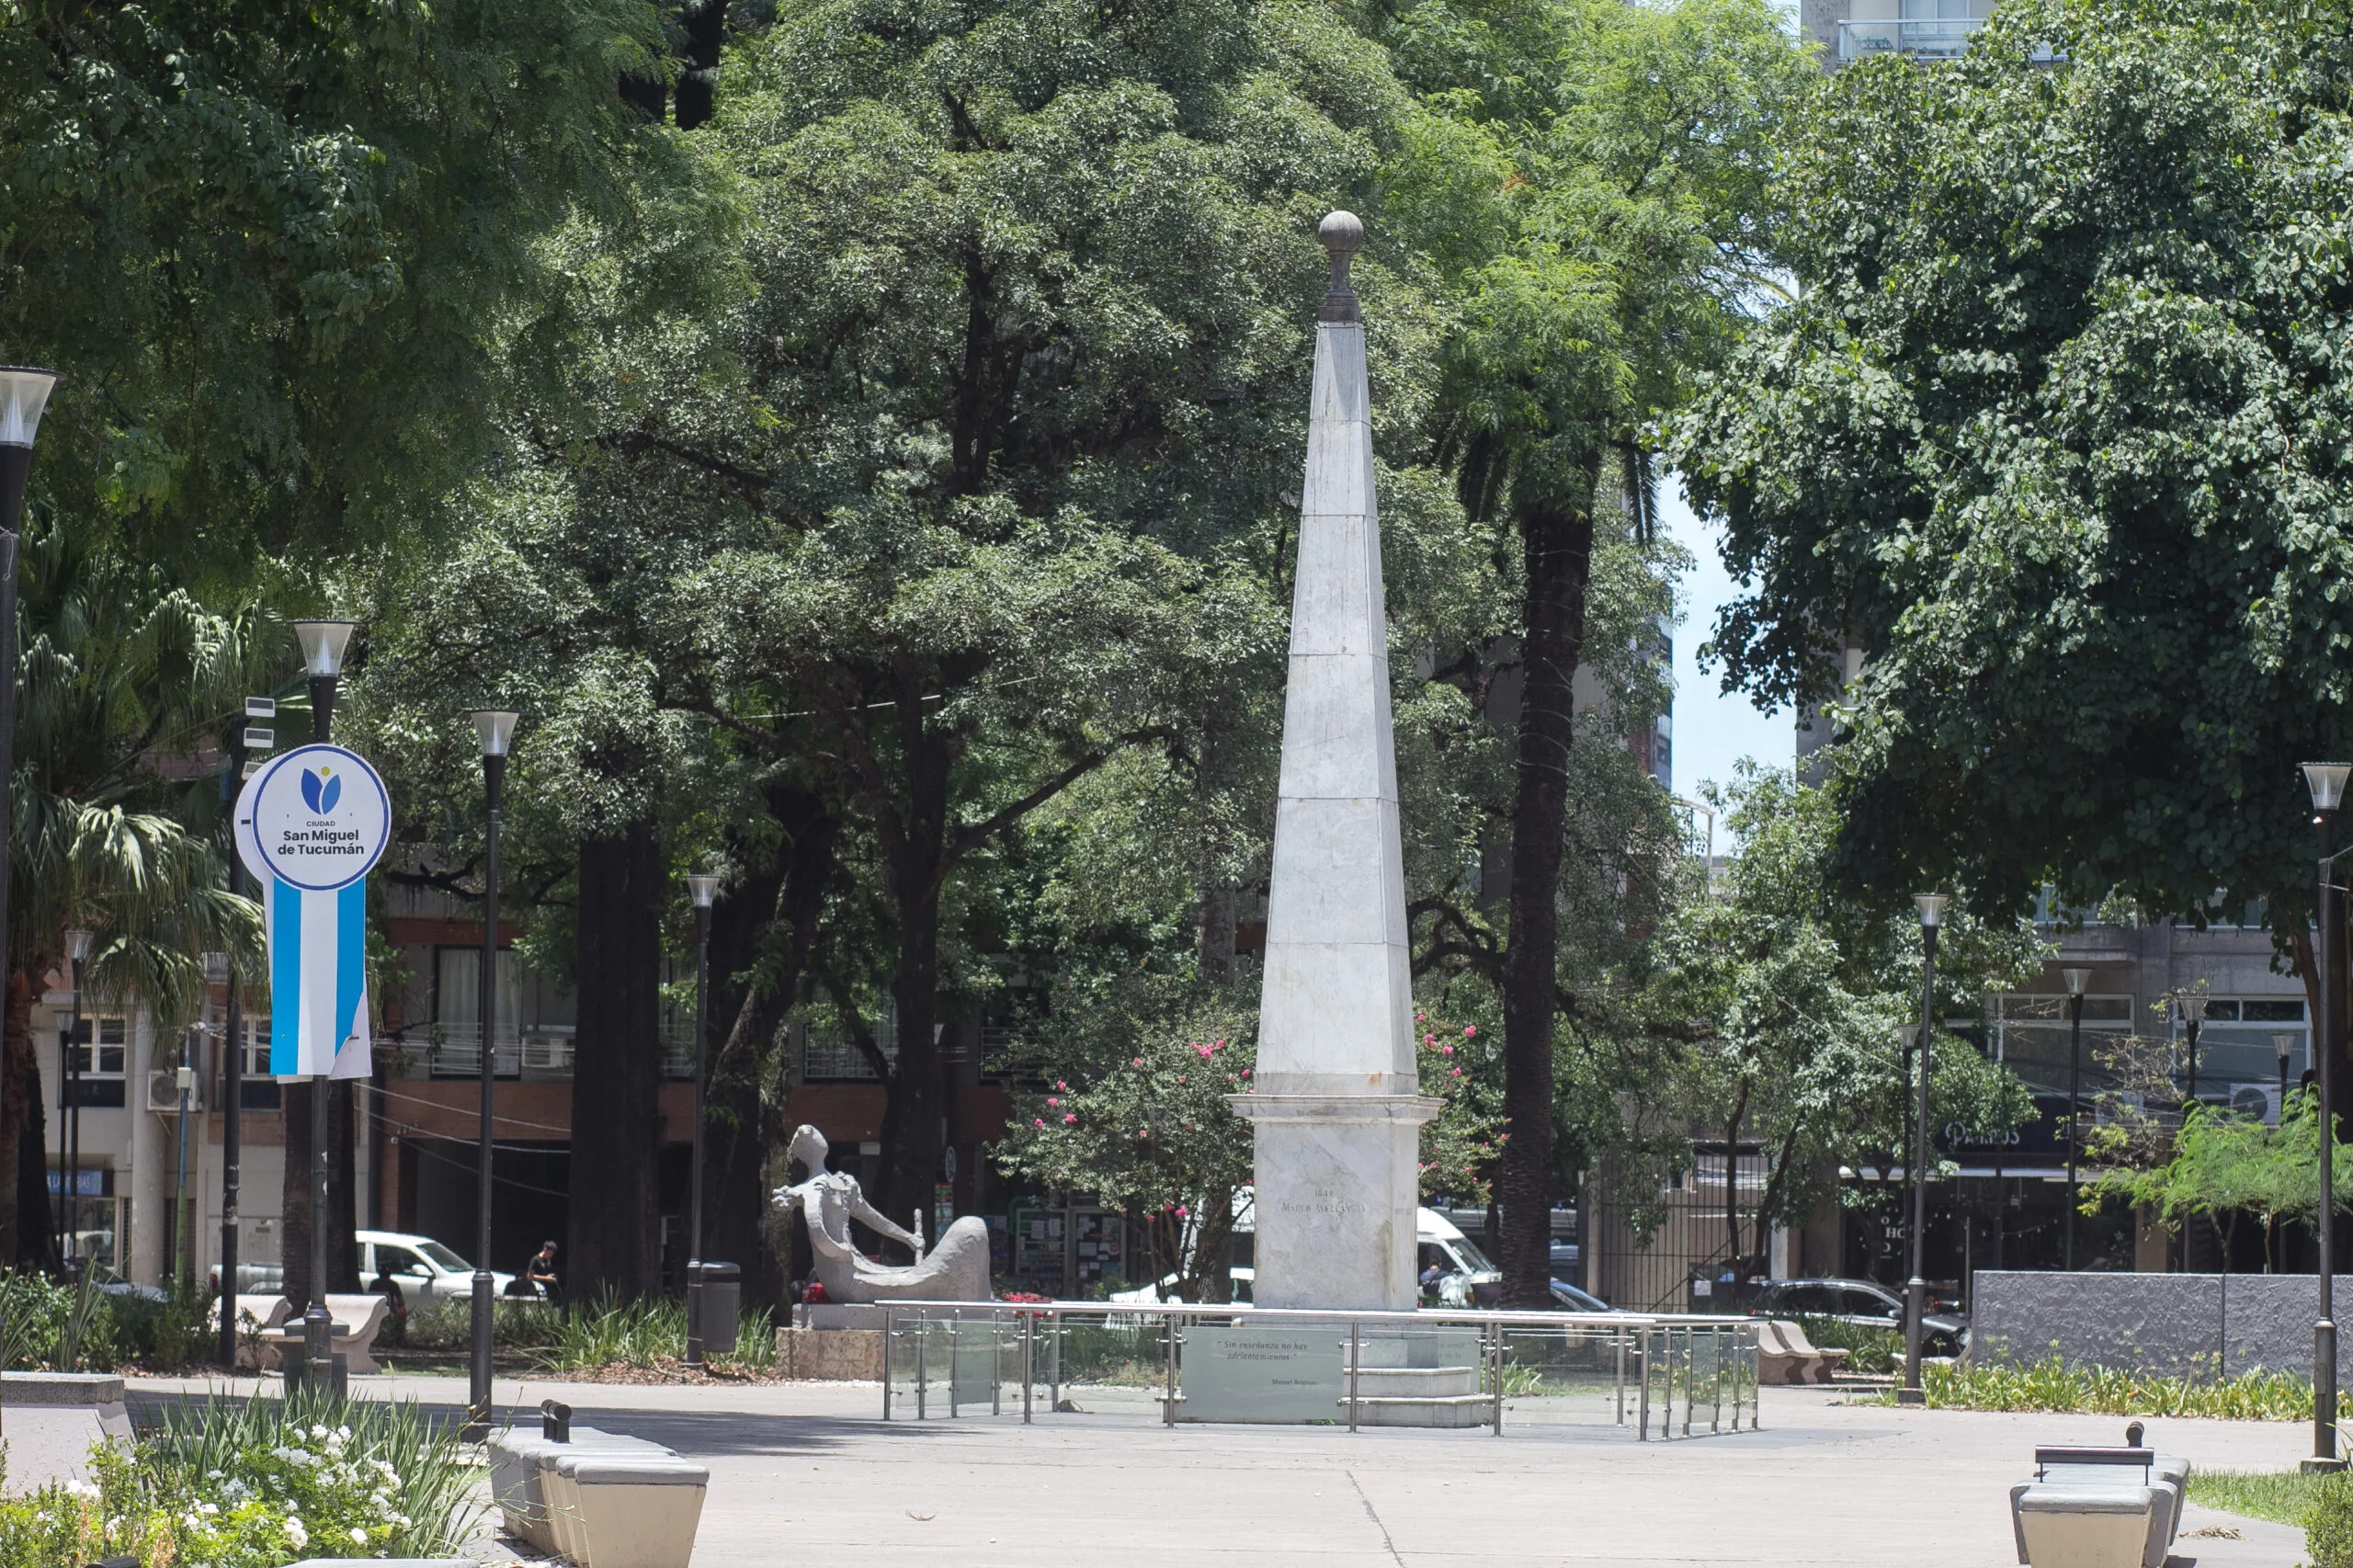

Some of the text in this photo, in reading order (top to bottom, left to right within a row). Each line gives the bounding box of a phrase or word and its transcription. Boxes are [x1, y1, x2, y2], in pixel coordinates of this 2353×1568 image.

[283, 829, 359, 845] San Miguel
[278, 843, 364, 855] de Tucumán
[1239, 1340, 1279, 1350] enseñanza
[1293, 1341, 1308, 1352] hay
